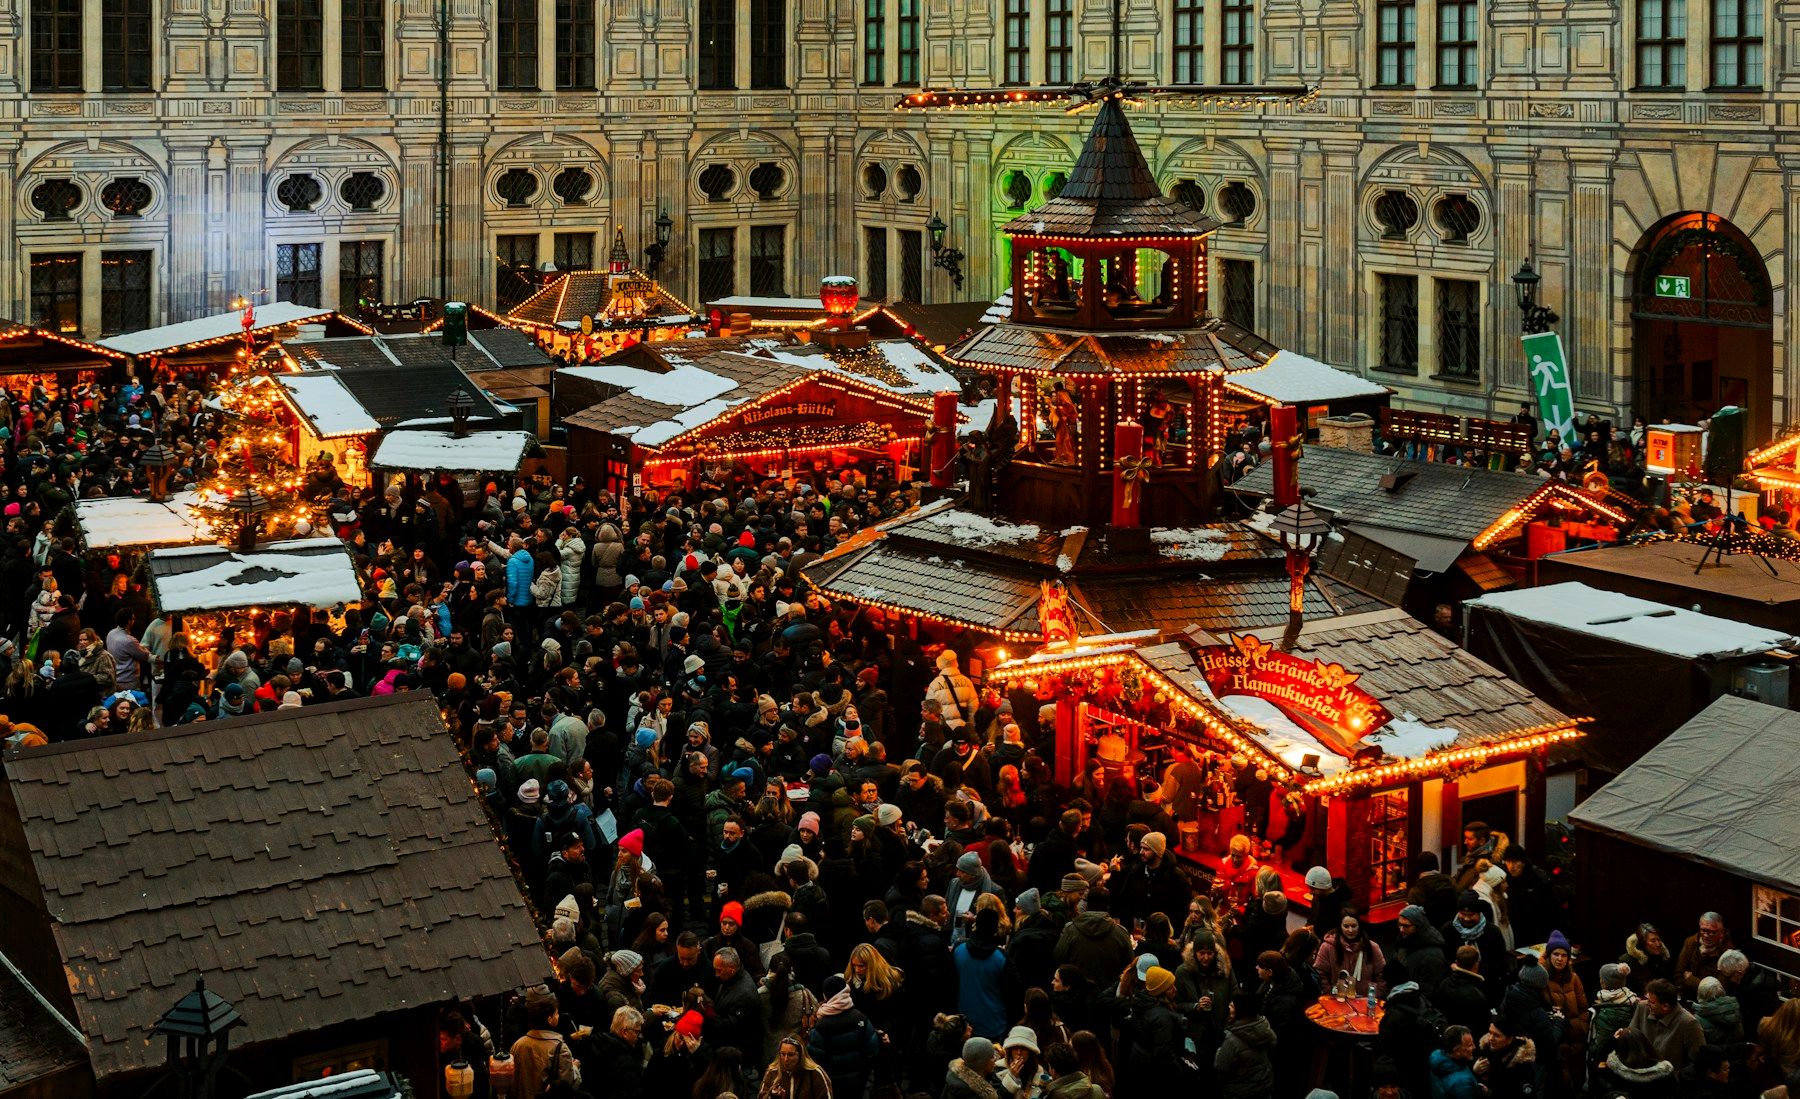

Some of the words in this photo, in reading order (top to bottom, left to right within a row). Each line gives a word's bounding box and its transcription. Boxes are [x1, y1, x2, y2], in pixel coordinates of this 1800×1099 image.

[1201, 654, 1250, 672] Heisse
[1254, 655, 1325, 689] Getränke
[1338, 687, 1378, 726] Wein
[1233, 674, 1342, 722] Flammkuchen
